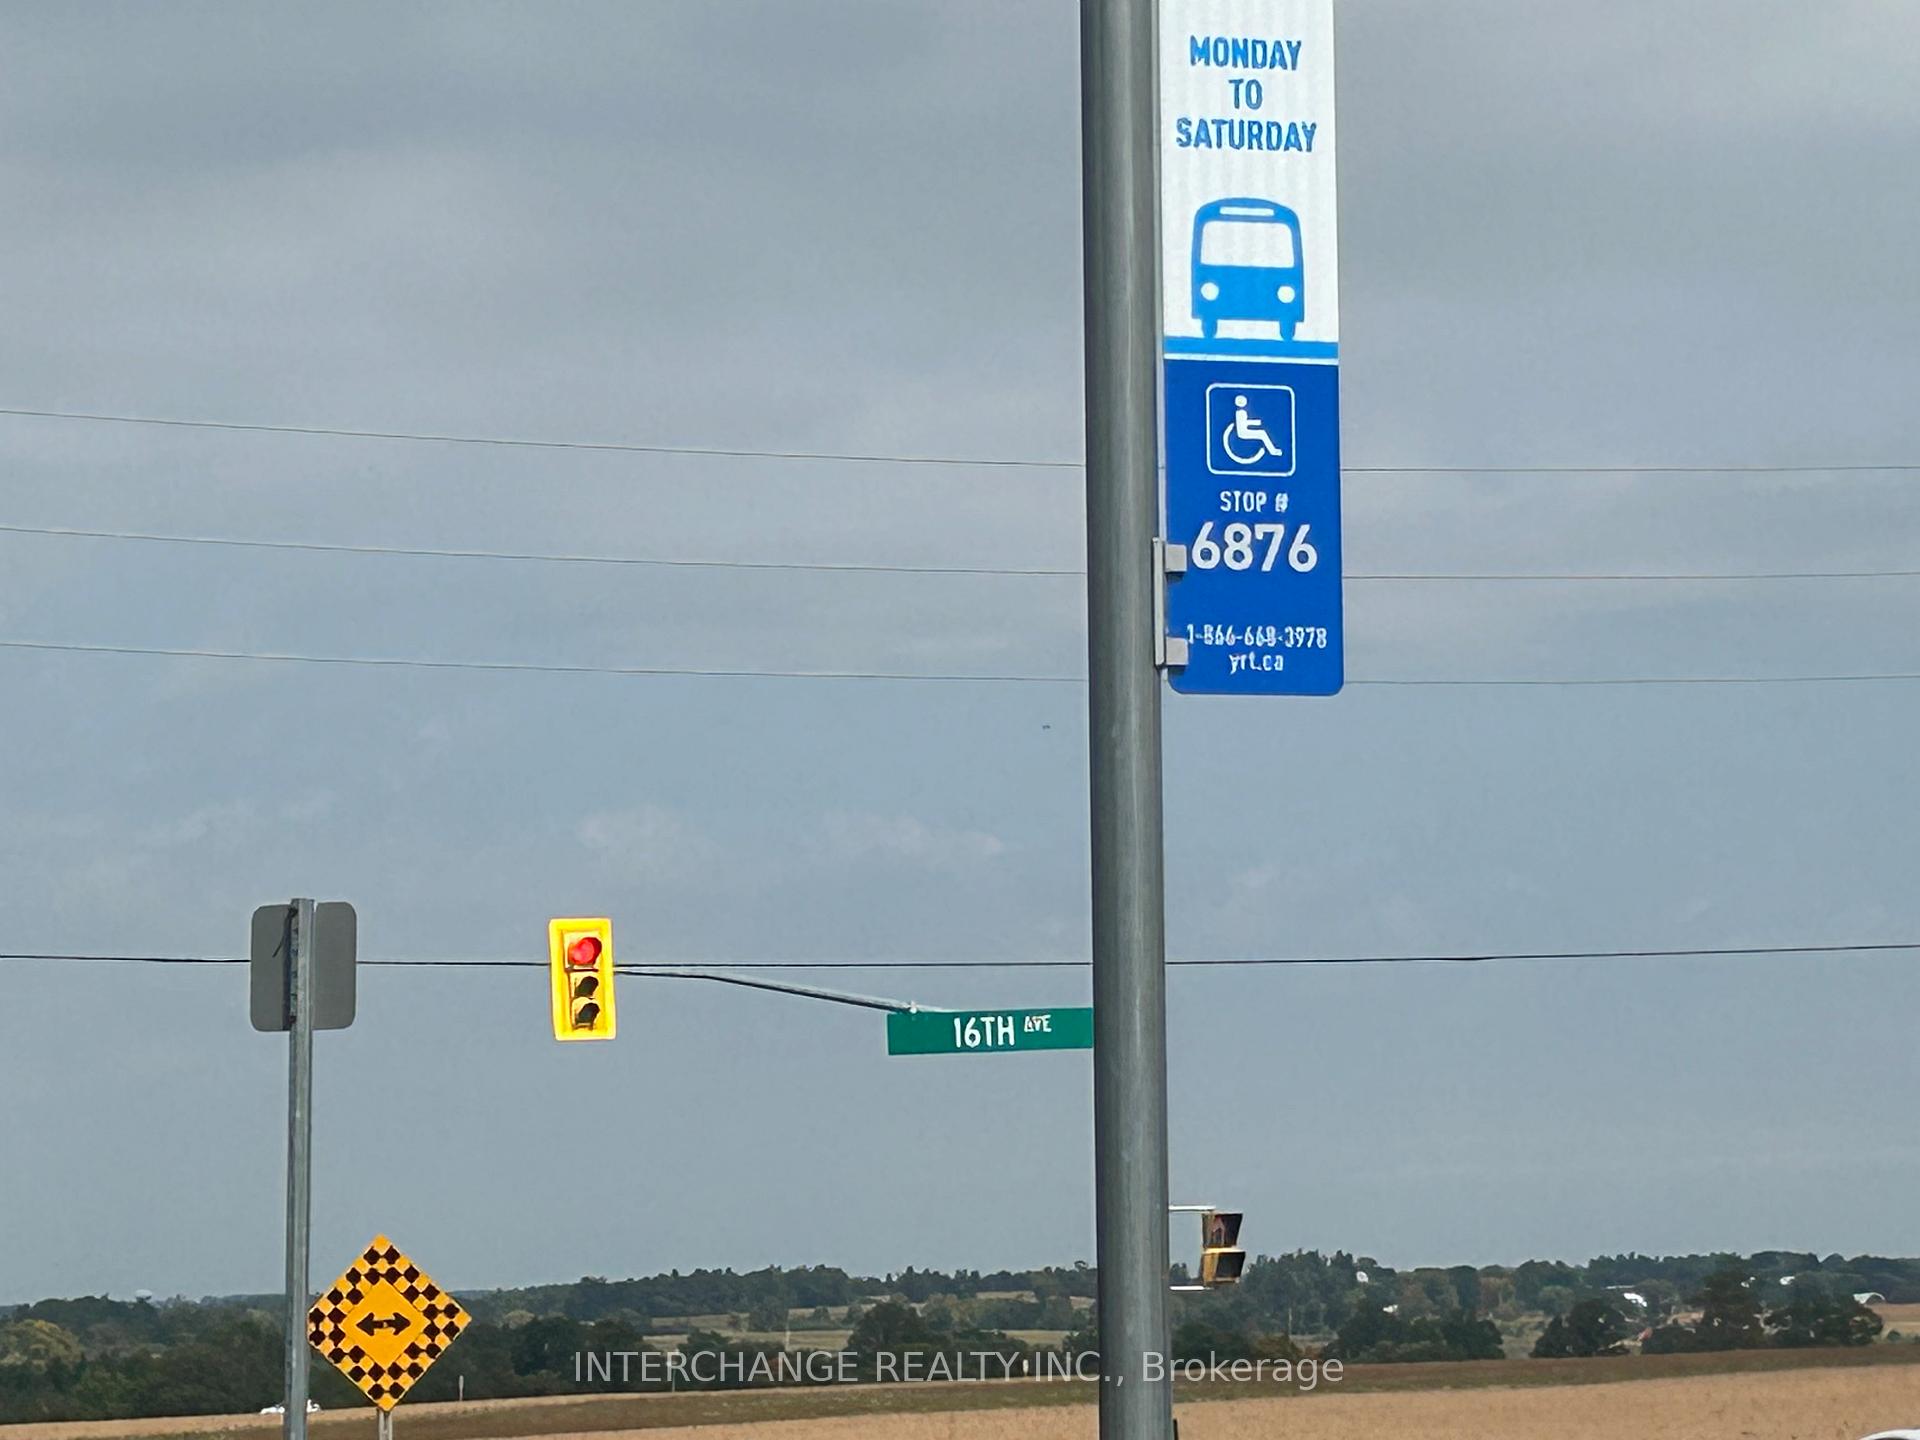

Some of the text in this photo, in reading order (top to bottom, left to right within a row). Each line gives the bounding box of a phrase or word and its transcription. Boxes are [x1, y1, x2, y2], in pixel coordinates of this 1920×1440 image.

[1189, 35, 1302, 71] MONDAY
[1228, 78, 1263, 110] TO
[1176, 117, 1317, 152] SATURDAY
[1219, 490, 1267, 513] STOP
[1191, 521, 1318, 573] 6876
[1229, 653, 1285, 675] yrt.ca
[954, 1014, 1052, 1048] 16TH AVE
